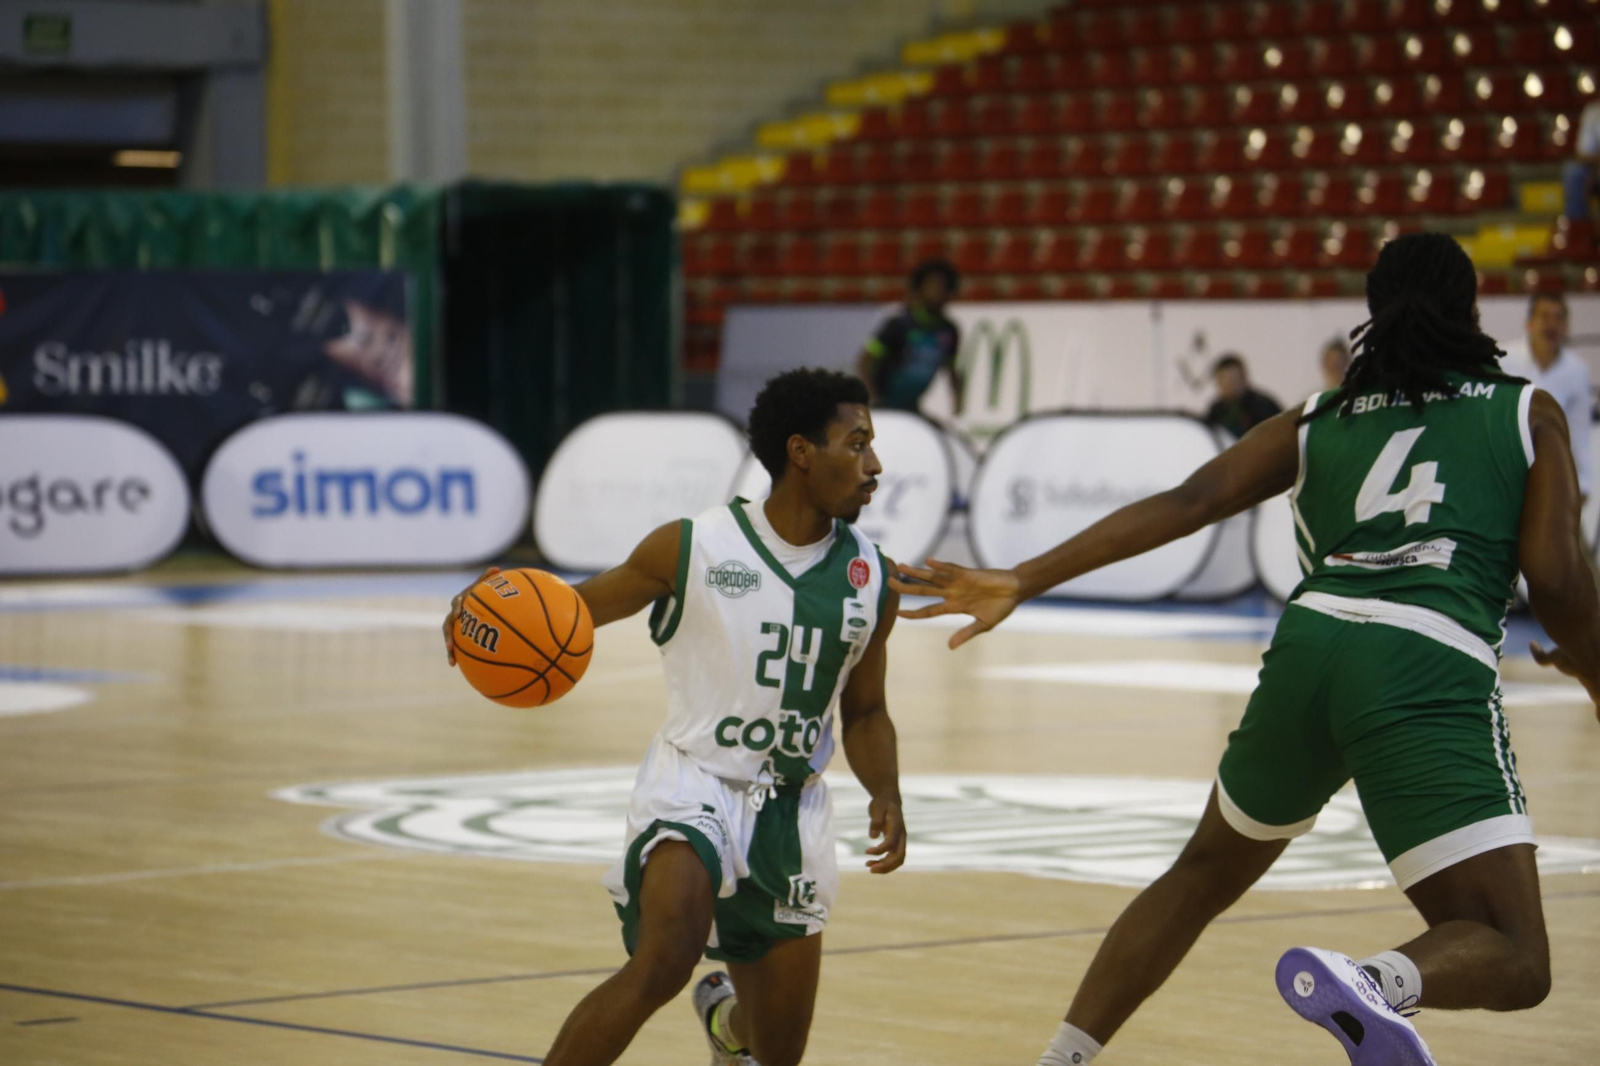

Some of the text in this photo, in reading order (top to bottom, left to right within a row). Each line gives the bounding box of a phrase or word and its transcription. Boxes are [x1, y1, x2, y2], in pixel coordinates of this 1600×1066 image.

[33, 339, 222, 396] Smilke
[0, 472, 151, 539] gare
[251, 450, 477, 517] simon
[1355, 426, 1446, 527] 4
[460, 608, 500, 653] Wils
[755, 621, 823, 691] 24
[714, 713, 821, 755] coto
